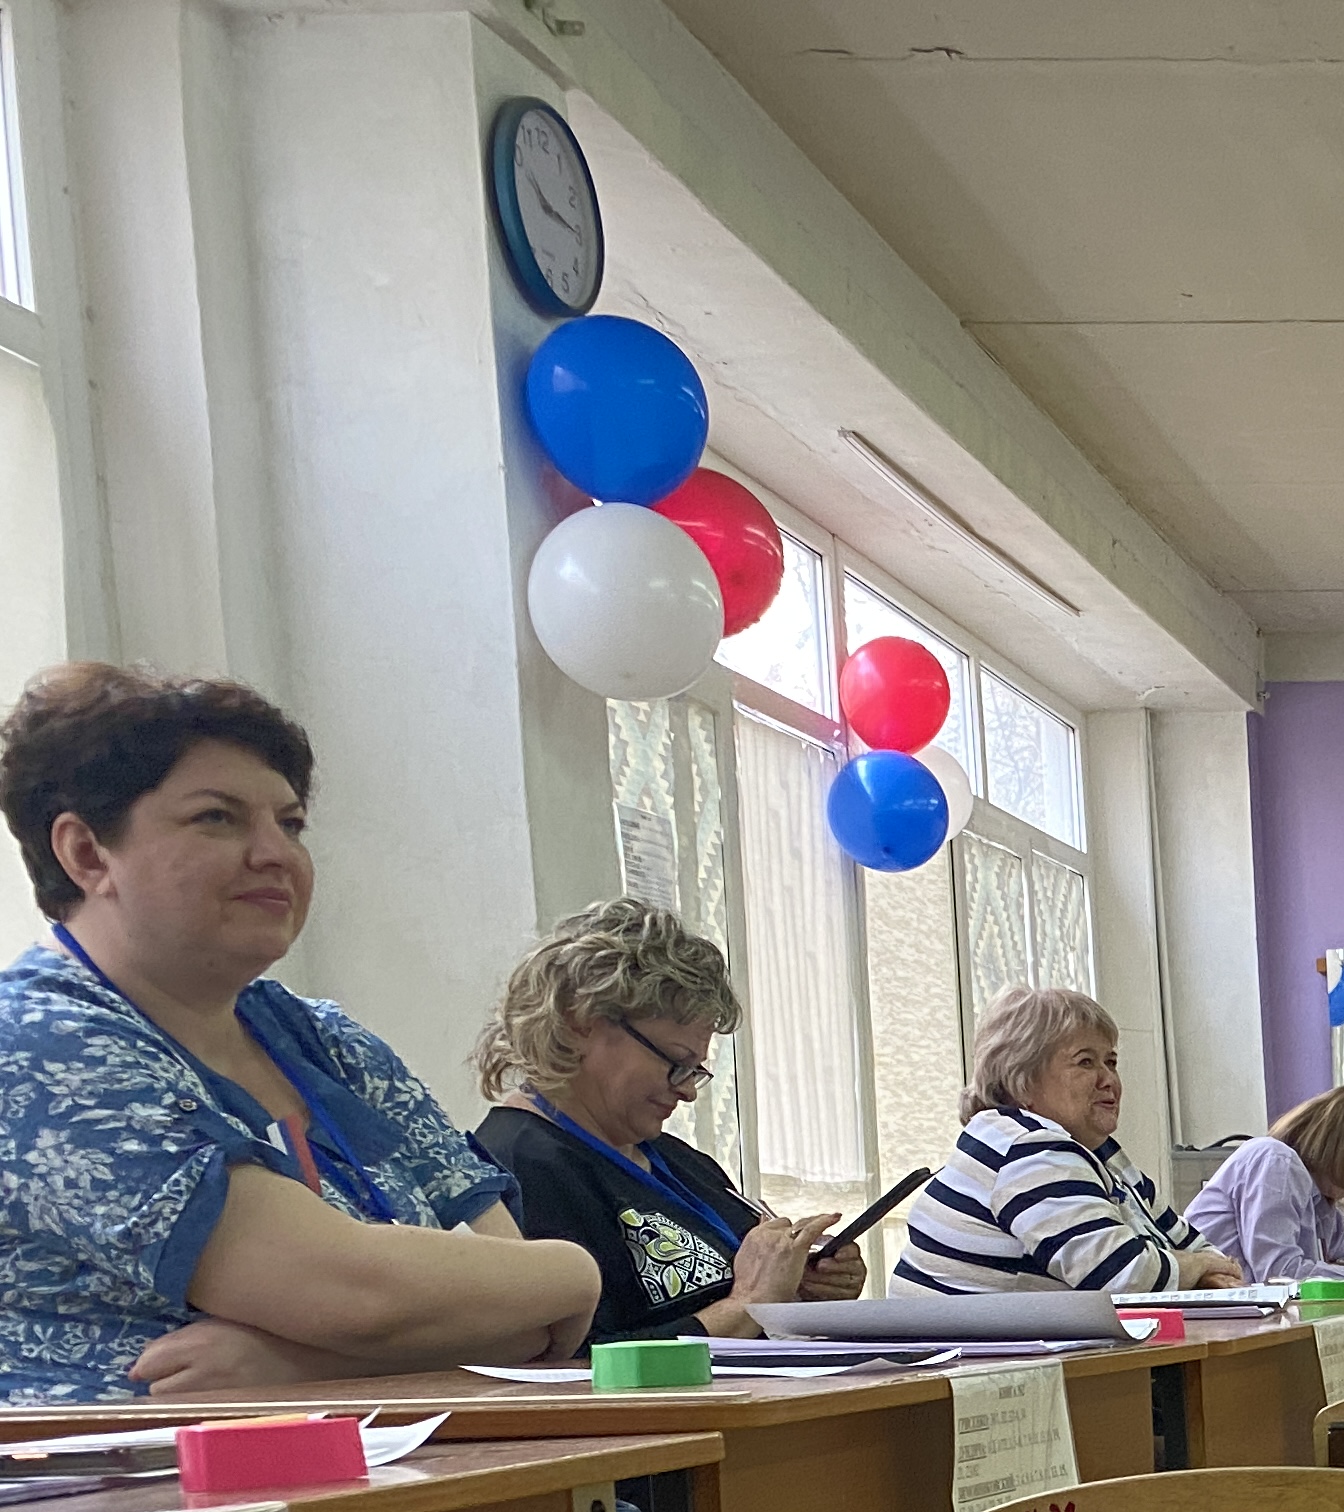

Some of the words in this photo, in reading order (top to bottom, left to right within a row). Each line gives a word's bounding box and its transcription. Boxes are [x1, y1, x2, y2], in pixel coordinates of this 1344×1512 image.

[534, 126, 550, 154] 12
[556, 153, 562, 175] 1
[568, 184, 577, 208] 2
[561, 271, 570, 294] 5
